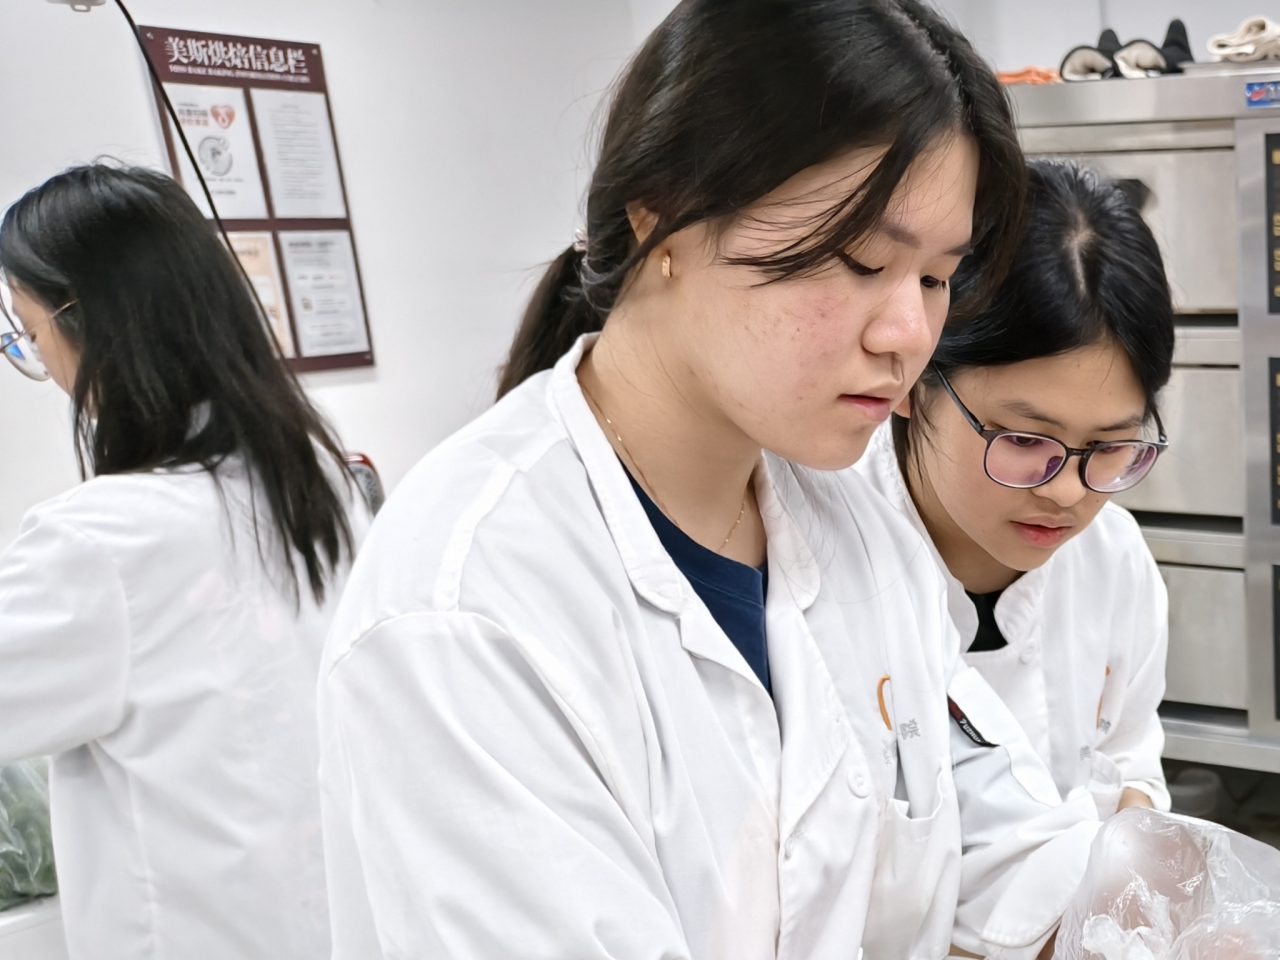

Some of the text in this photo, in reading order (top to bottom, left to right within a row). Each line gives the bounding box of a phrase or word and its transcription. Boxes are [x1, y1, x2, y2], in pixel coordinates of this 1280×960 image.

[165, 36, 307, 74] 美斯烘焙信息栏
